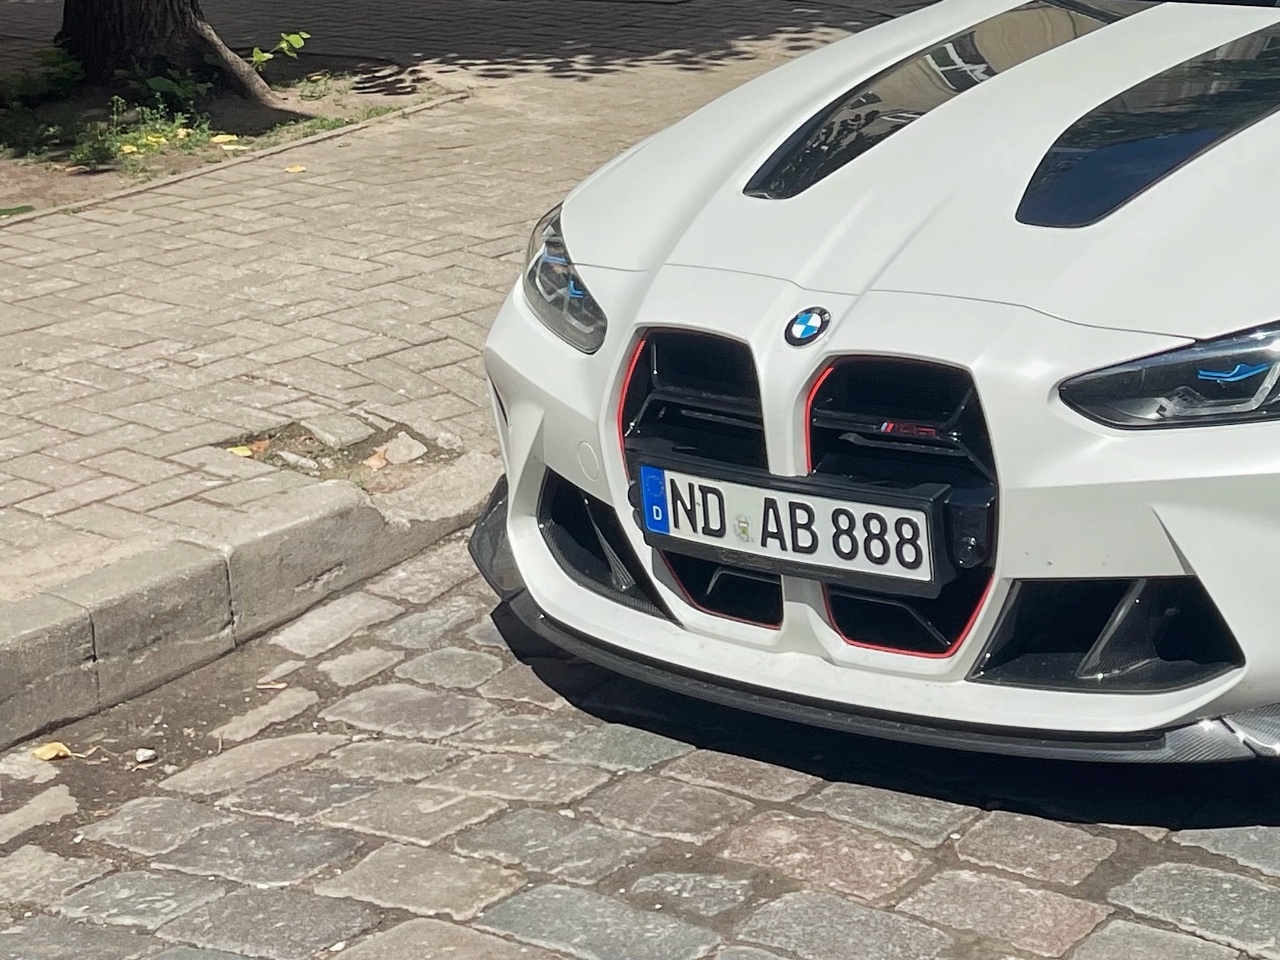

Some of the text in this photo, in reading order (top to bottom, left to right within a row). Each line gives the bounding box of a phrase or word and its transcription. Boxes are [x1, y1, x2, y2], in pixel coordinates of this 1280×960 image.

[653, 505, 663, 522] D
[670, 478, 923, 570] ND AB 888
